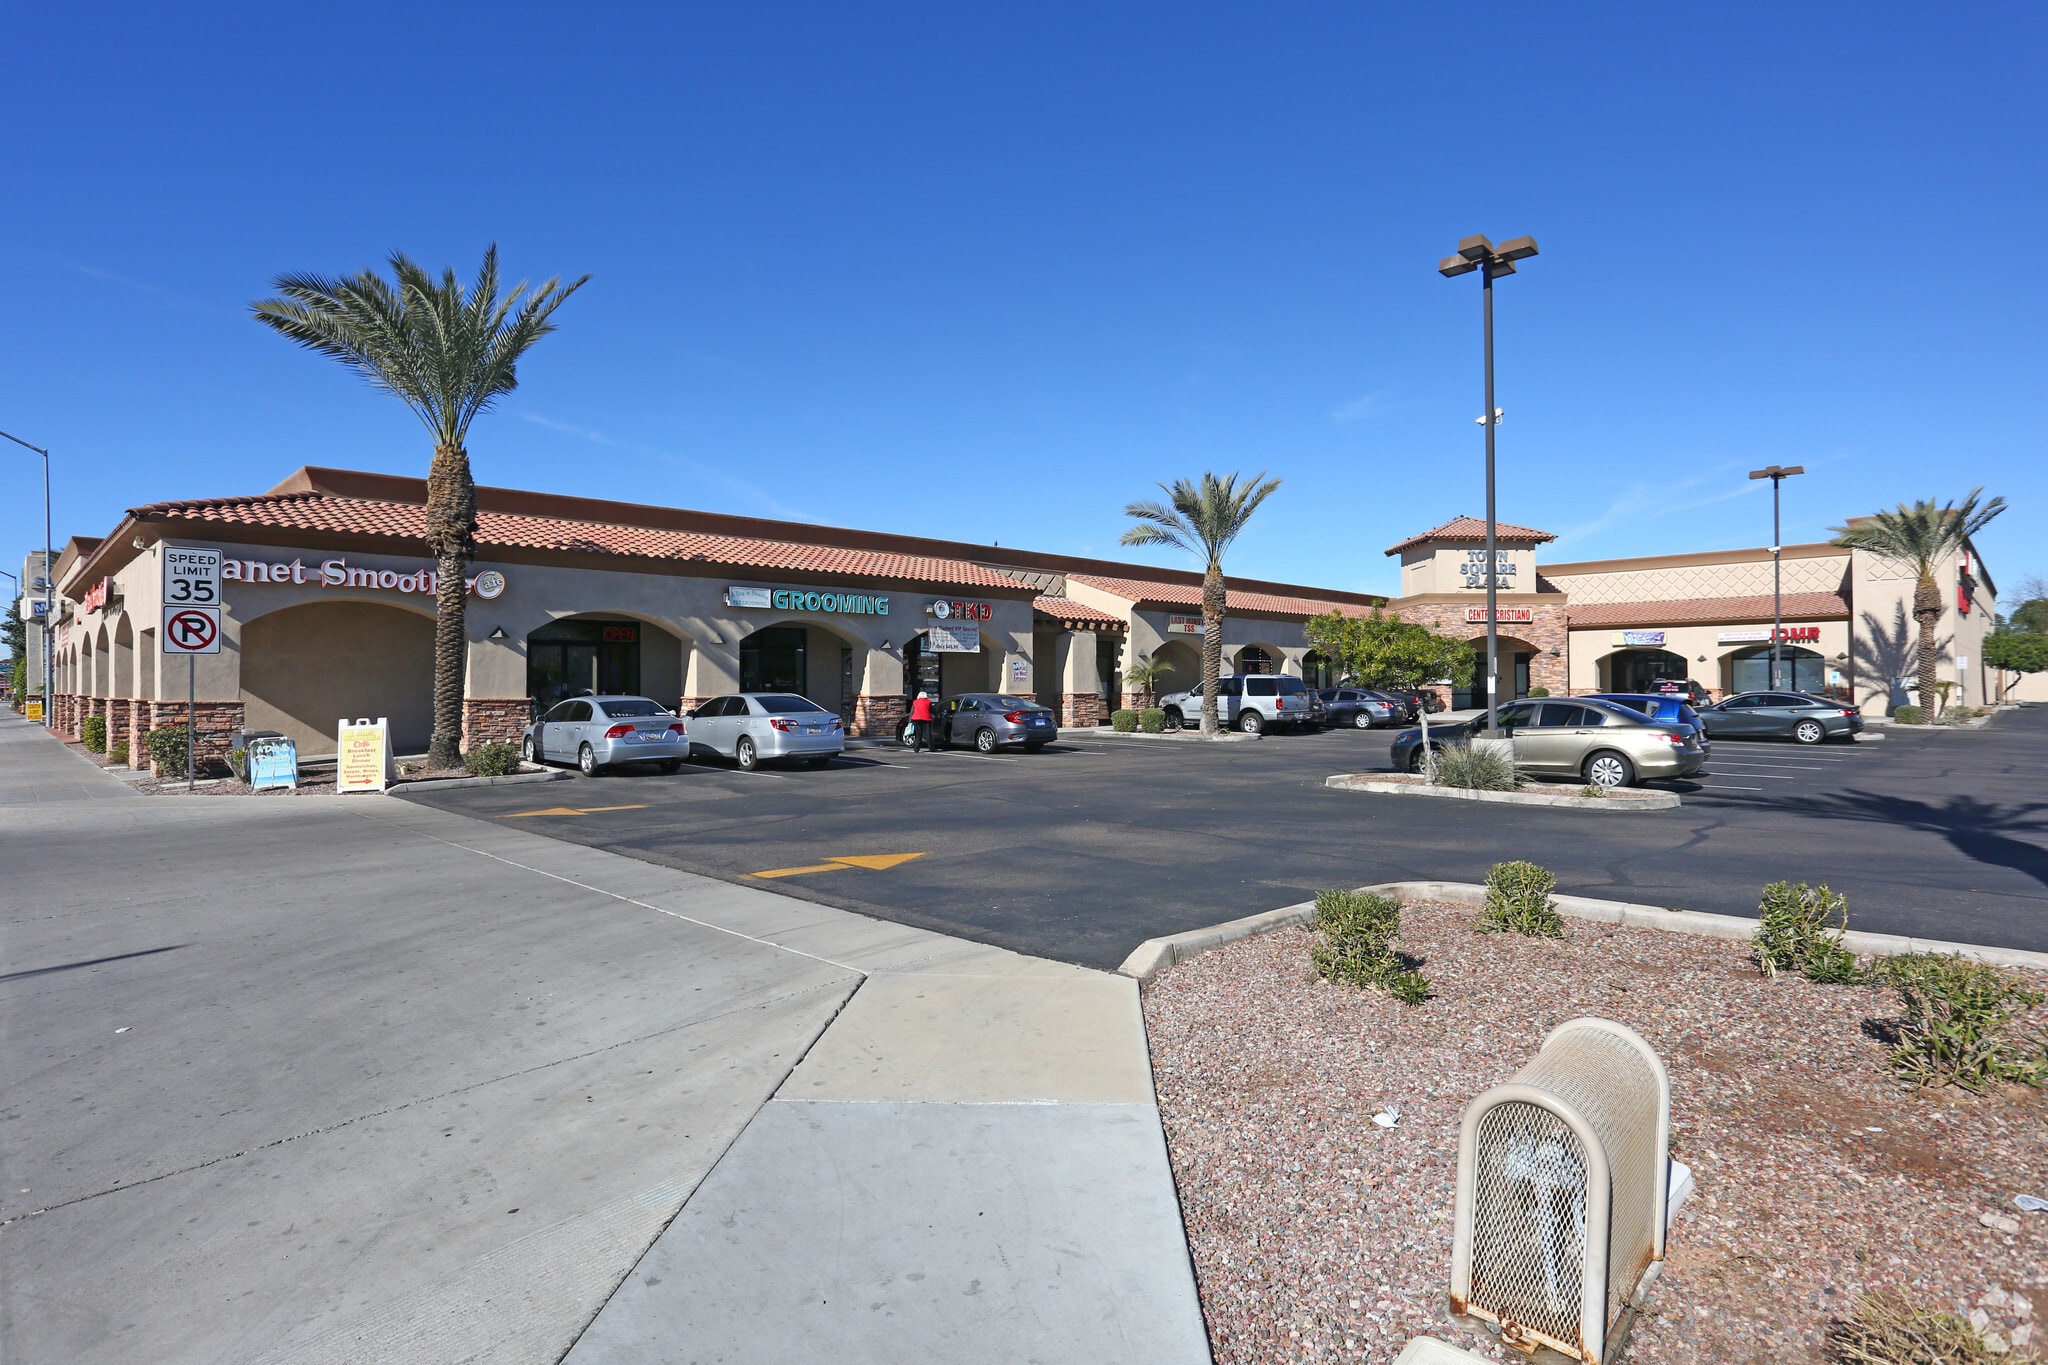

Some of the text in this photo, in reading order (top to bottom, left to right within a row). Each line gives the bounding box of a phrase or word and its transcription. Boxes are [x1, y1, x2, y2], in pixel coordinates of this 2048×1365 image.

[168, 554, 216, 565] SPEED
[1468, 551, 1508, 562] TON
[174, 566, 211, 576] LIMIT
[222, 558, 306, 584] anet
[1460, 564, 1516, 576] SQURE
[170, 579, 214, 602] 35
[773, 590, 888, 615] GROOMING
[952, 602, 992, 620] TKD
[1468, 609, 1530, 620] CENTR CRISTIANO
[1171, 616, 1205, 625] LAST MINUT
[605, 629, 635, 640] OPEN
